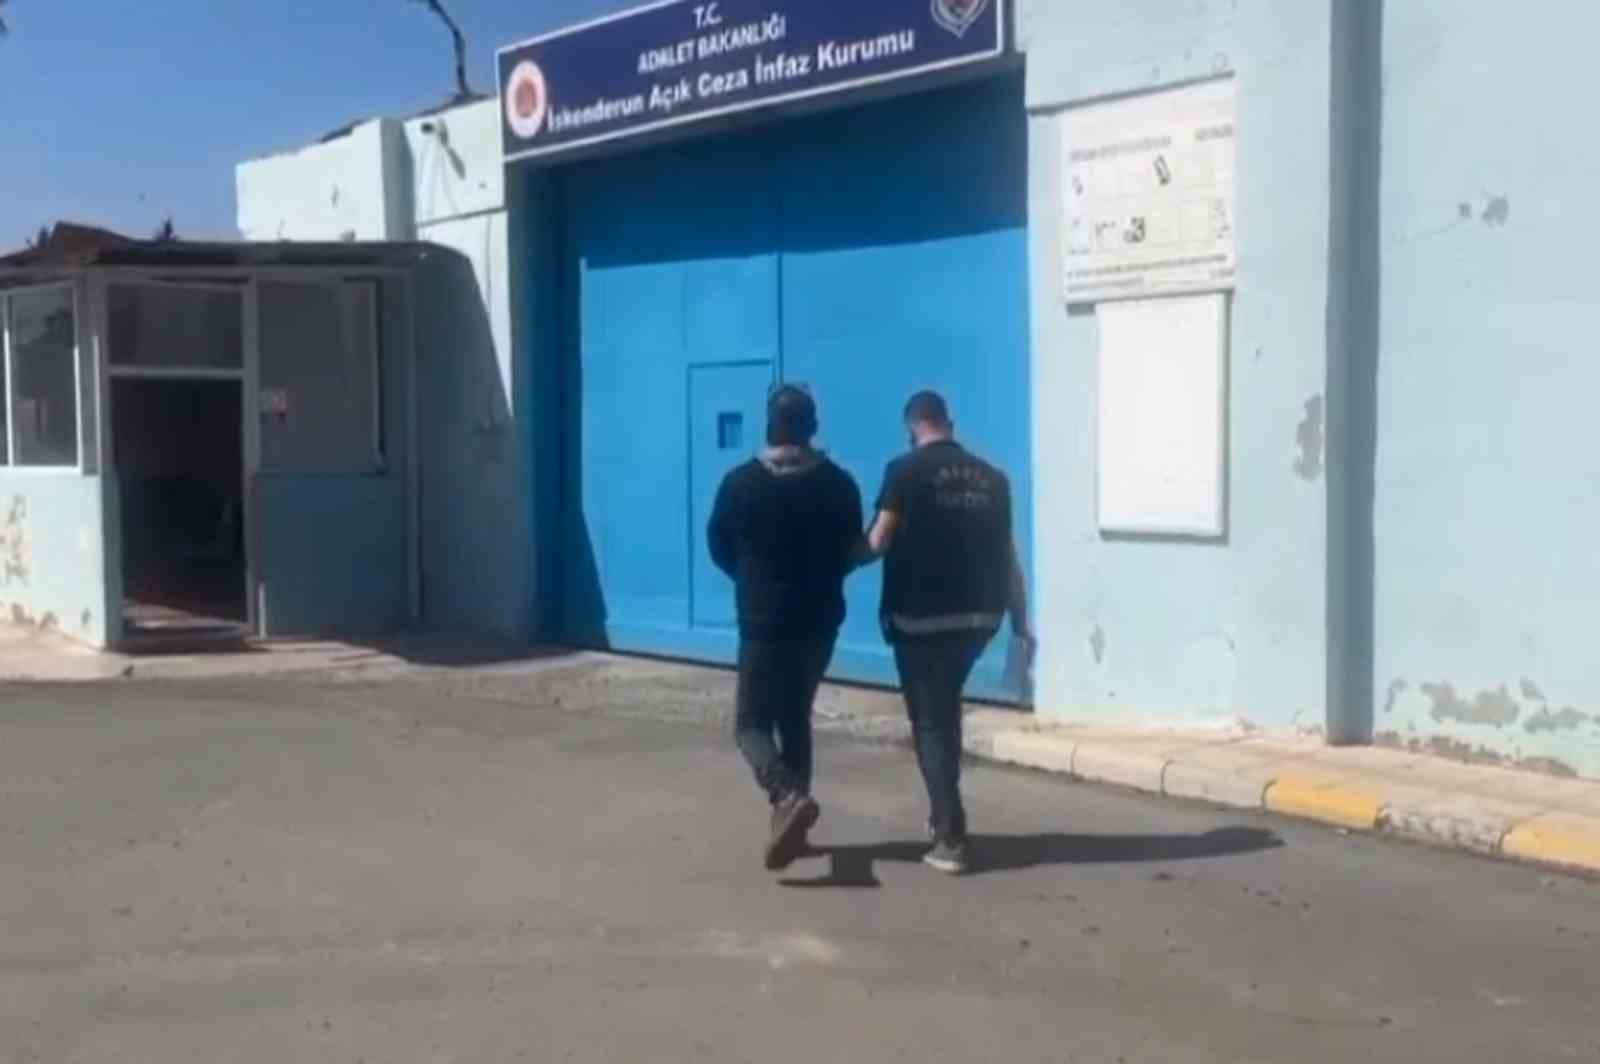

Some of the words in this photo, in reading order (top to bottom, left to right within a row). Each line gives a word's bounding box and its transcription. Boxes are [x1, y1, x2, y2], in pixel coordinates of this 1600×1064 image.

[547, 94, 645, 132] İskenderun
[649, 77, 692, 112] Açık
[698, 68, 749, 97] Ceza
[755, 52, 812, 84] İnfaz
[817, 28, 916, 72] Kurumu
[637, 40, 695, 74] ADALET
[698, 12, 787, 59] BAKANLIĞI
